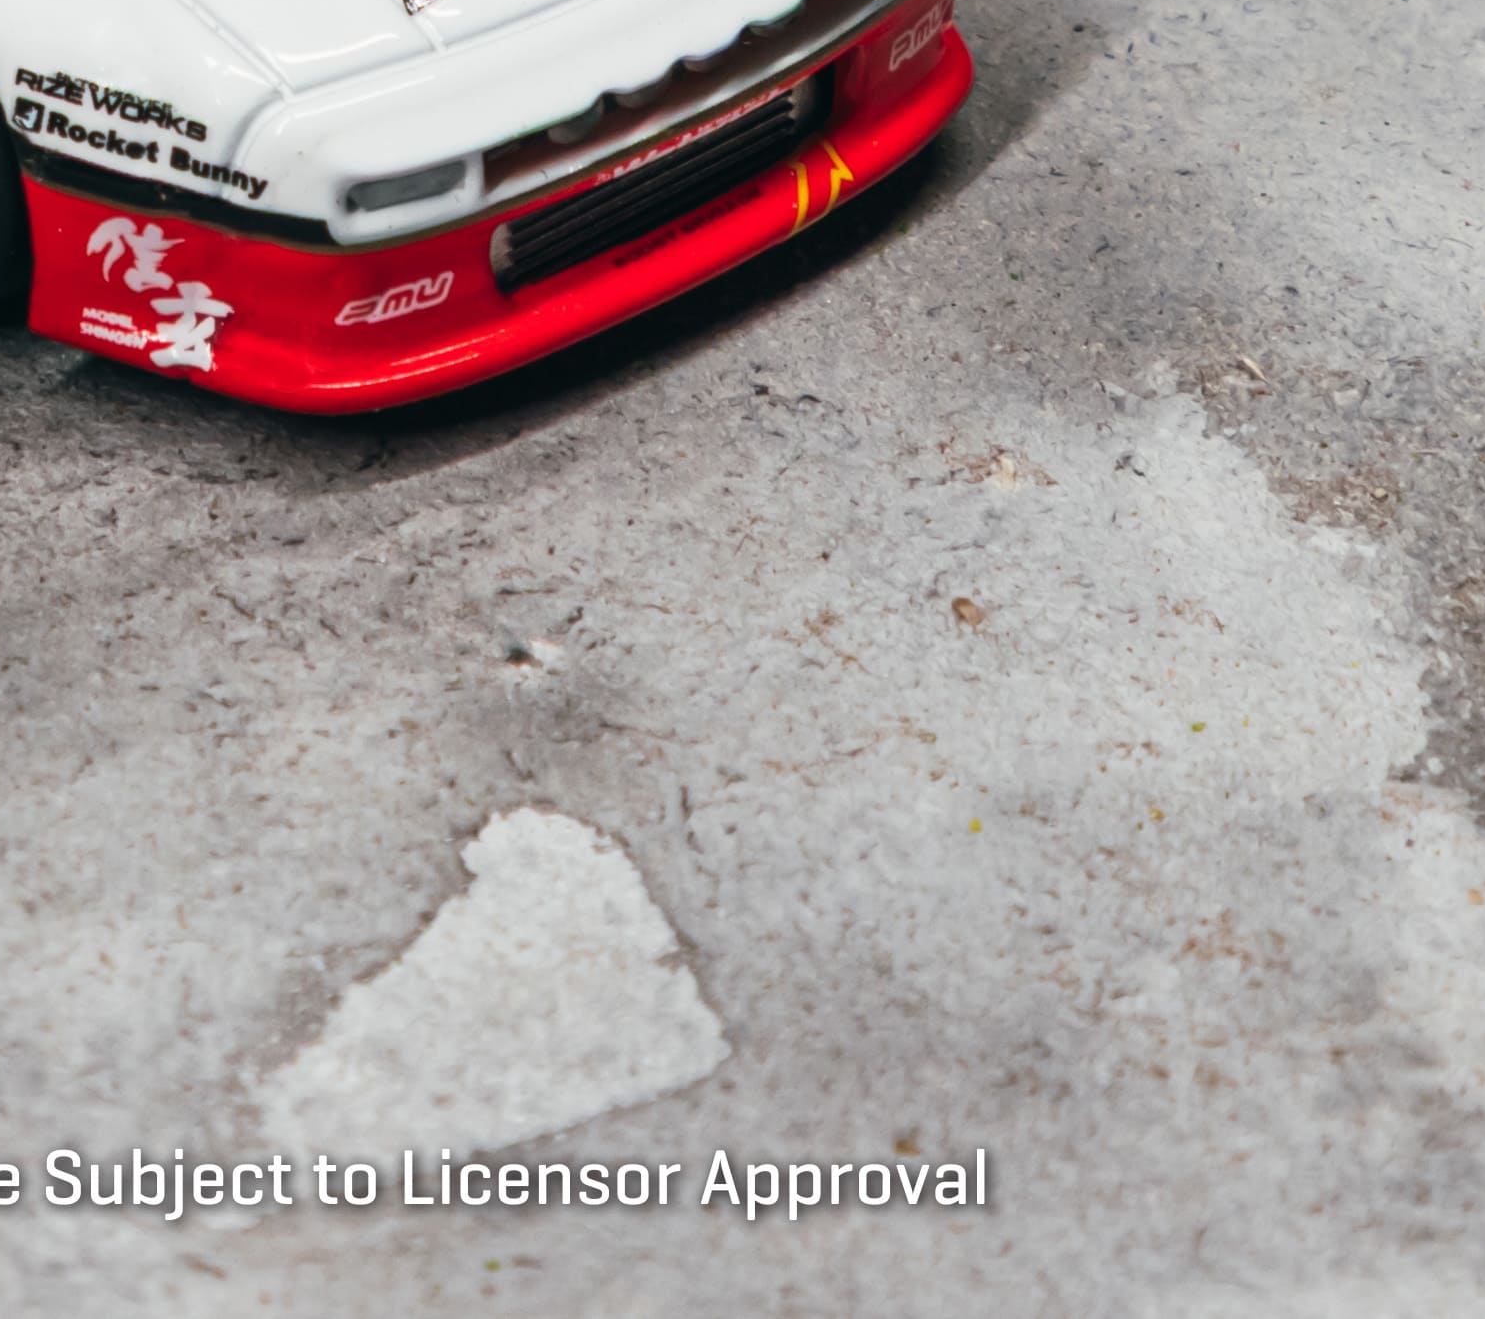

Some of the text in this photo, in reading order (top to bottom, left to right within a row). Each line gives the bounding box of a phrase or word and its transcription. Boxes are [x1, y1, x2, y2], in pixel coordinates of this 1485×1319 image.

[87, 81, 208, 143] WORKS
[45, 110, 269, 201] Rocket Bunny
